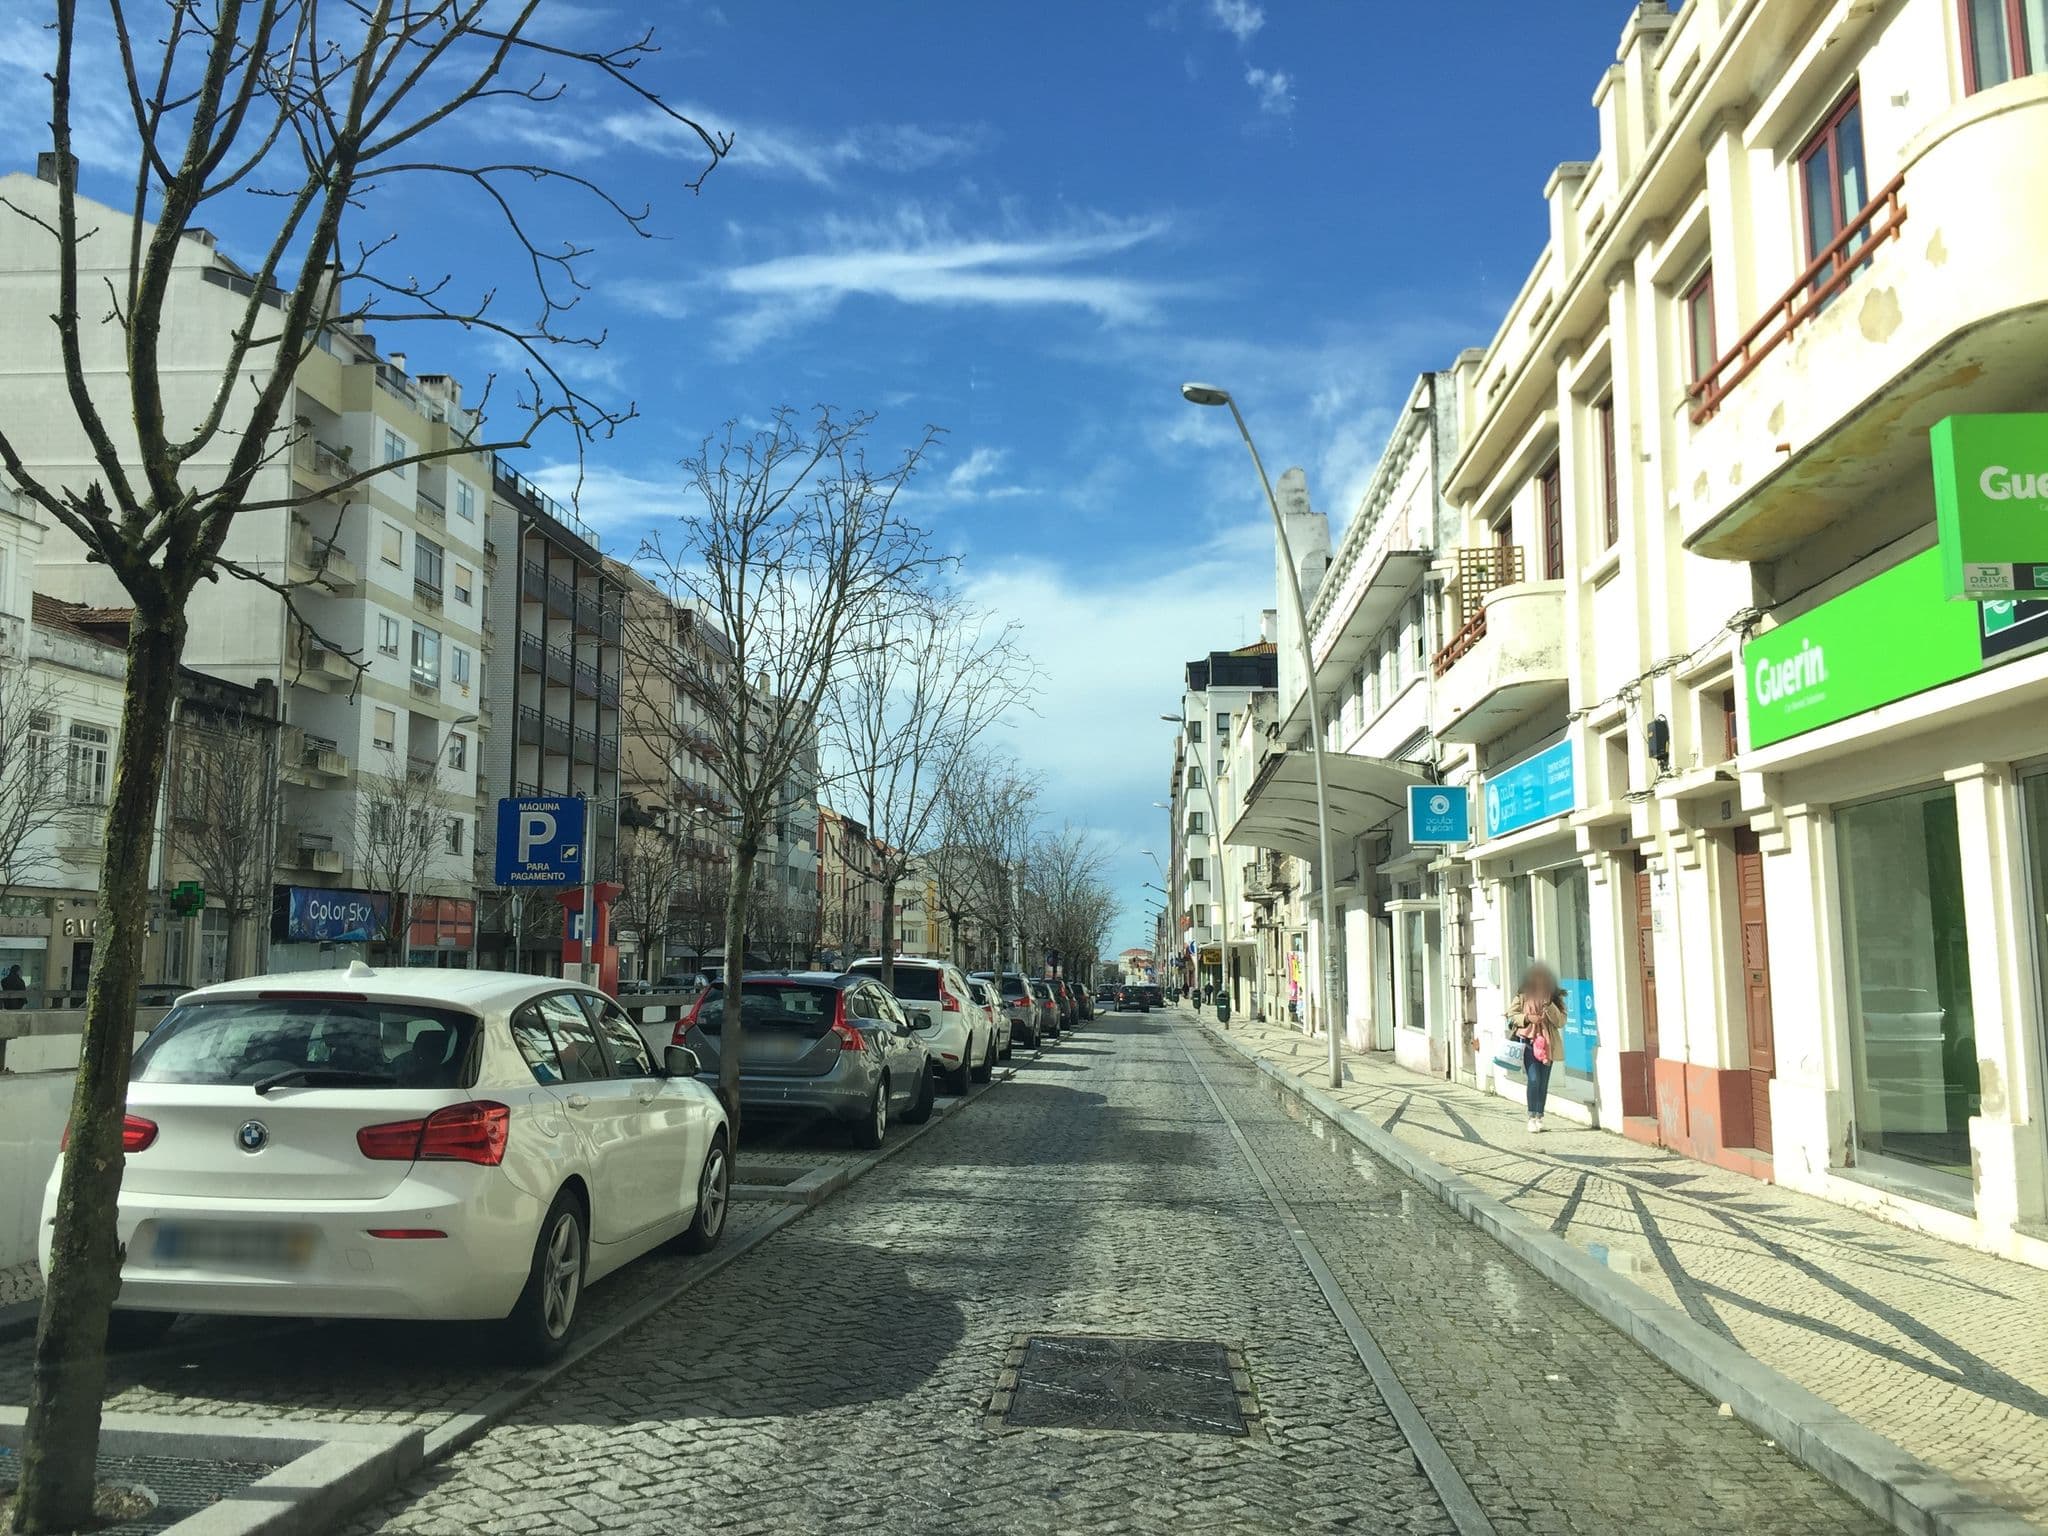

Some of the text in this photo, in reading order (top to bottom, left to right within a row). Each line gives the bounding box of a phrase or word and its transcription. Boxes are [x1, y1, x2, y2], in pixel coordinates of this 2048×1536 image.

[1755, 637, 1824, 706] Guerin
[519, 802, 560, 811] MÁQUINA
[1426, 816, 1453, 825] ocular
[518, 811, 557, 863] P
[511, 872, 566, 881] PAGAMENTO
[309, 900, 371, 922] Color Sky
